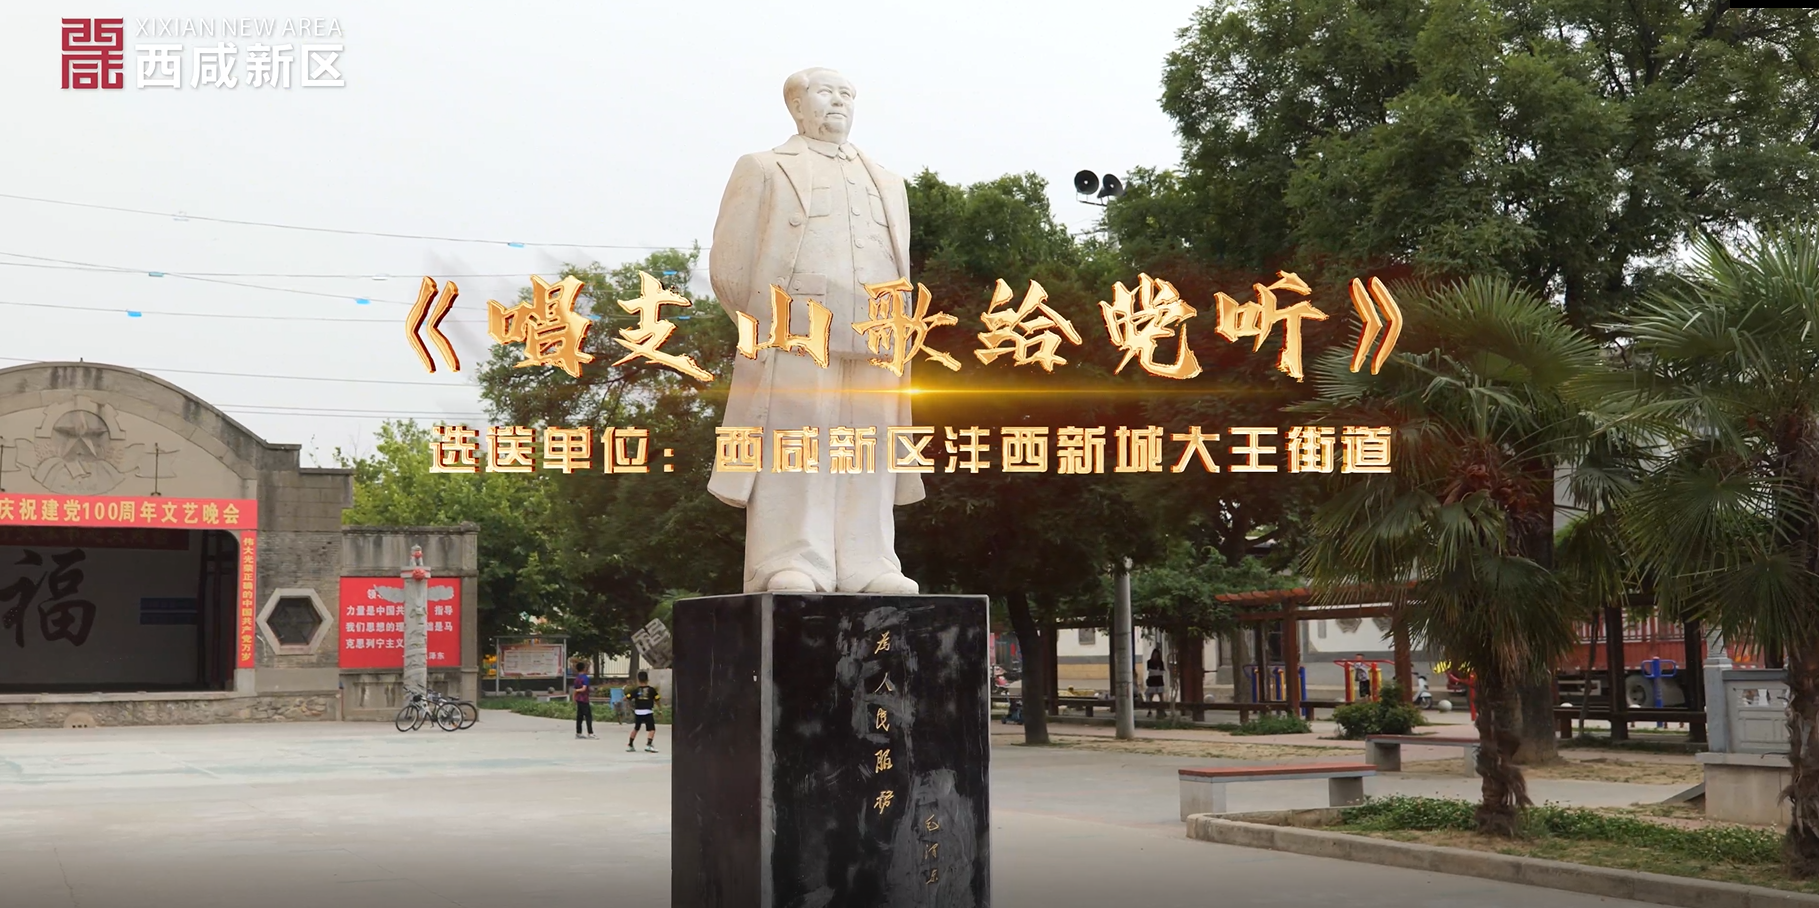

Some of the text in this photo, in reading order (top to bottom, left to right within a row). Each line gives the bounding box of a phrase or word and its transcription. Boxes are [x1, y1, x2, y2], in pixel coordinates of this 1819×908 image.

[0, 497, 240, 525] 庆祝建党100周年文艺晚会
[346, 605, 405, 616] 力量是中国共
